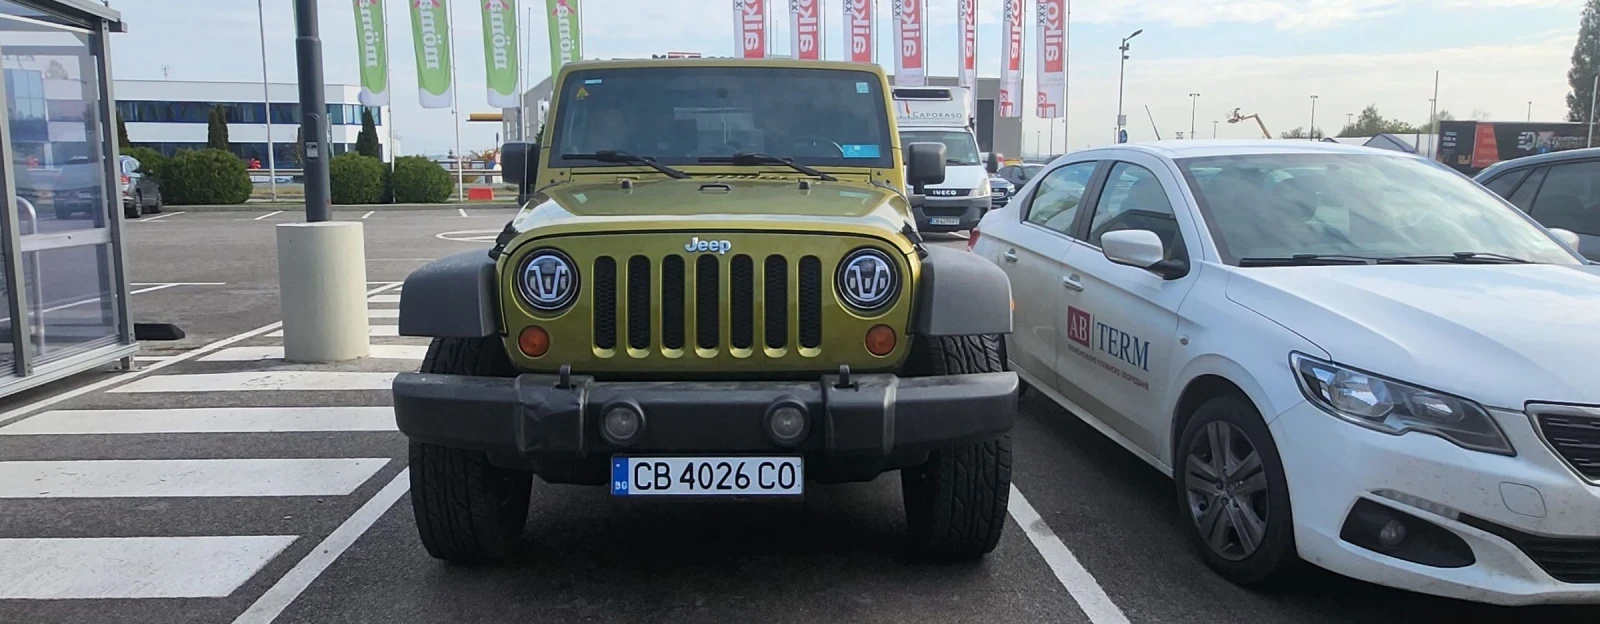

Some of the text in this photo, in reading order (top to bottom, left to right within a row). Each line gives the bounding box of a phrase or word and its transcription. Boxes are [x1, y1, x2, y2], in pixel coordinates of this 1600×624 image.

[684, 236, 732, 255] Jeep
[1069, 312, 1088, 342] AB
[1096, 321, 1151, 372] TERM
[634, 461, 672, 491] CB
[679, 461, 751, 491] 4026
